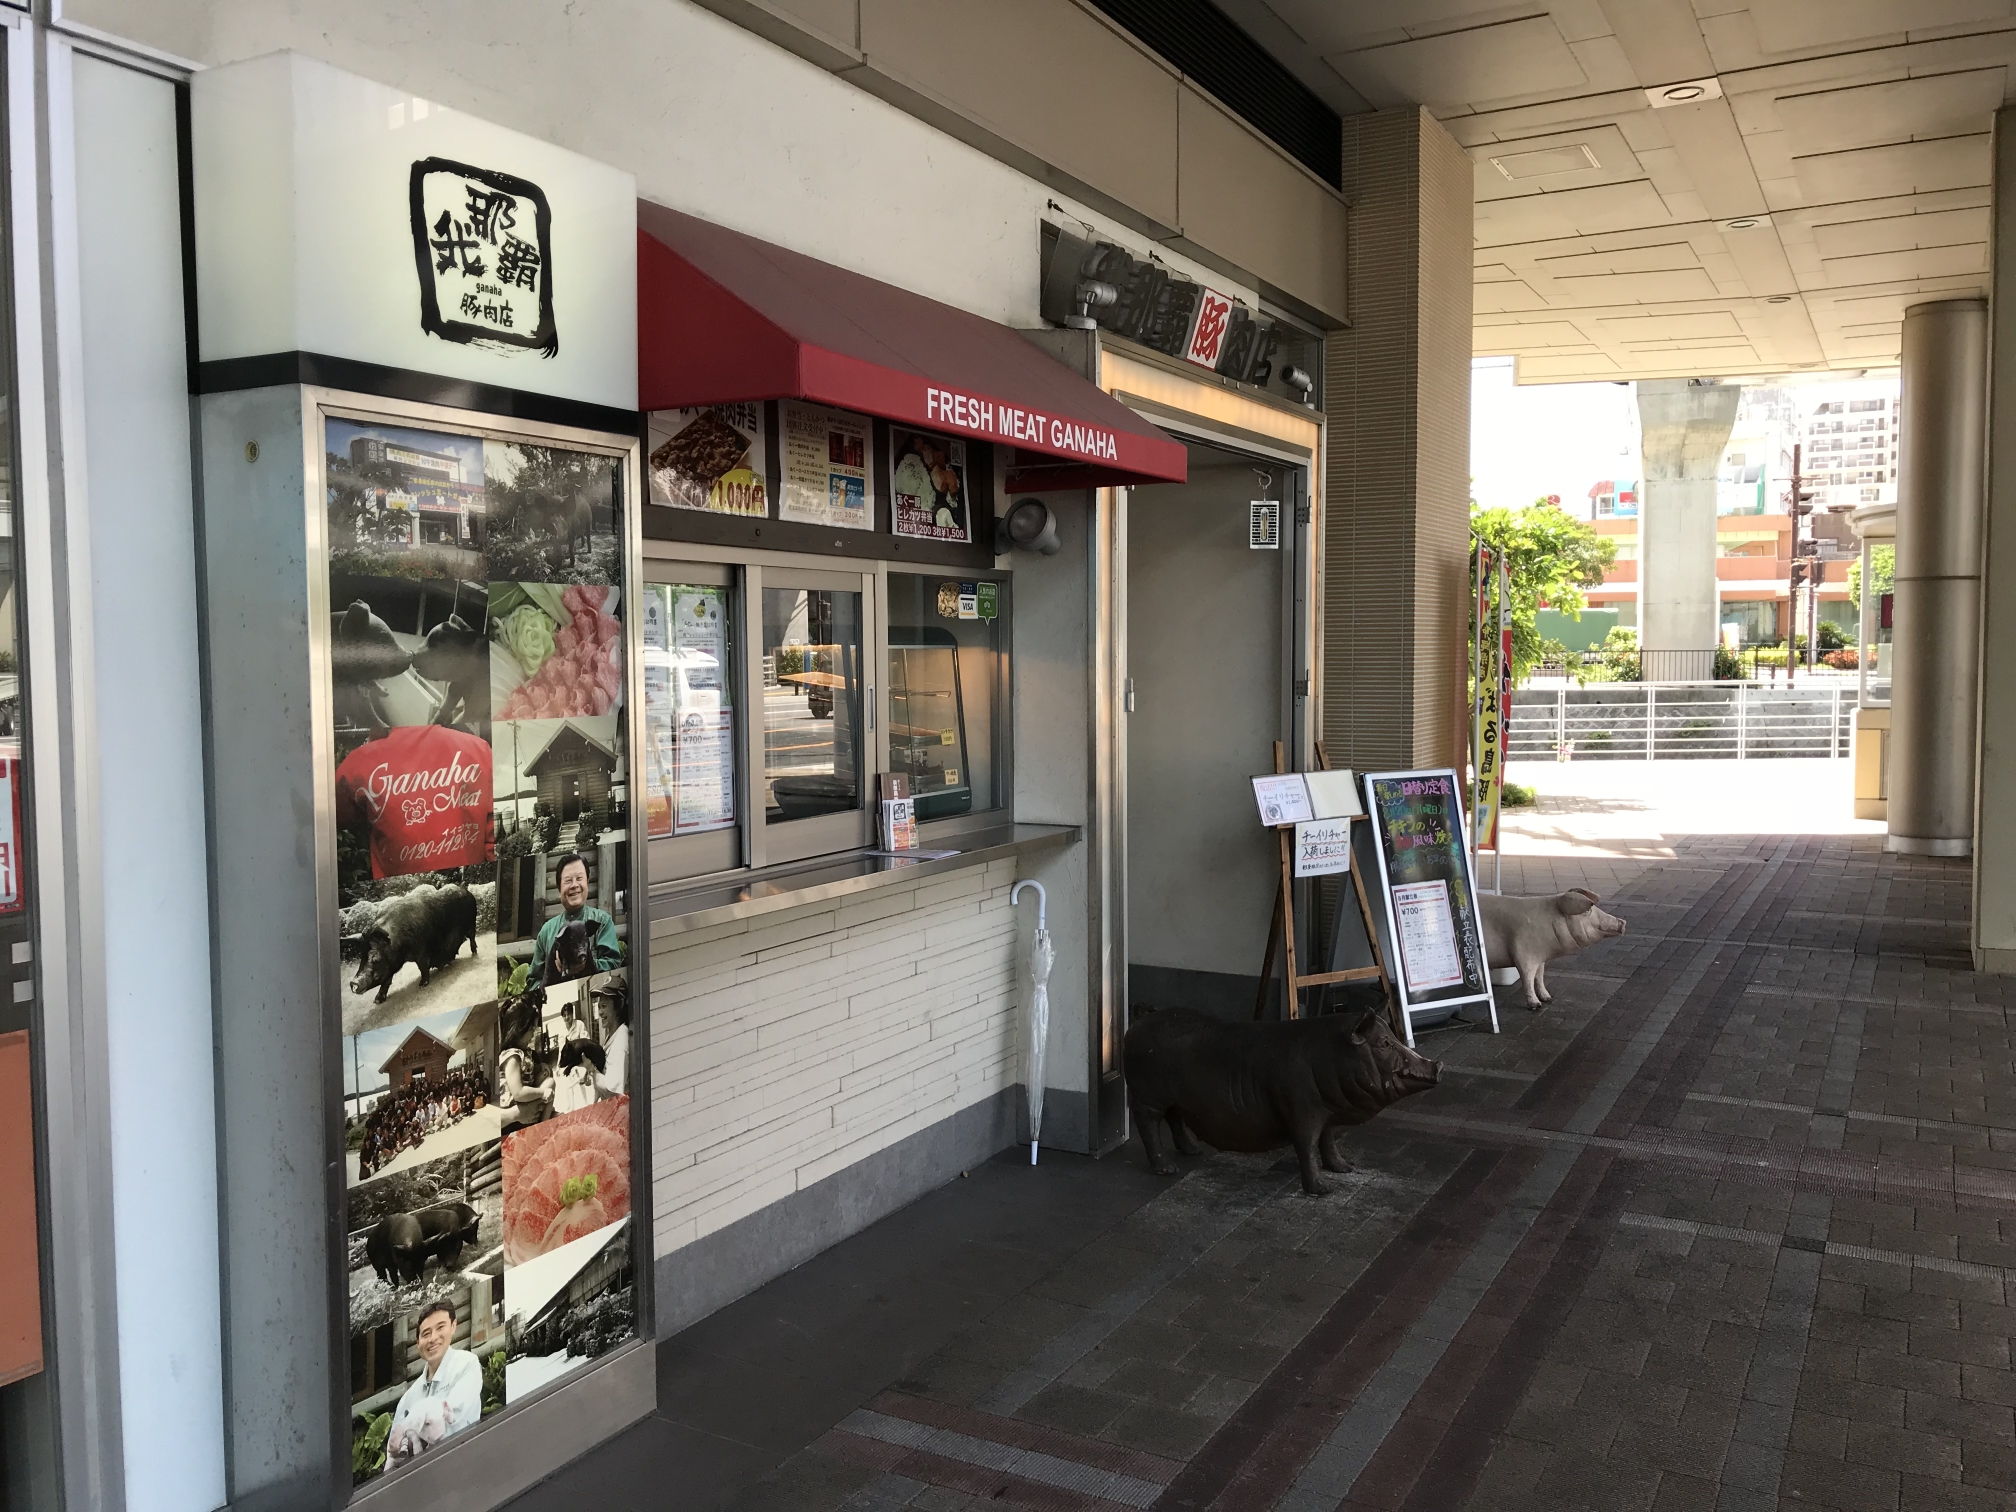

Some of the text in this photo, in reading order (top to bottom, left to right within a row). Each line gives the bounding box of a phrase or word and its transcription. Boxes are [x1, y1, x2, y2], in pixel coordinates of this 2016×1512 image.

[475, 282, 503, 296] ganaha
[460, 292, 514, 328] 豚肉店
[927, 387, 1118, 461] FRESH MEAT GANAHA
[897, 508, 933, 523] ヒレカツ弁当
[898, 522, 964, 539] 2枚¥1,200 3枚¥1,500
[962, 602, 974, 611] VISA
[682, 735, 703, 745] ¥700
[355, 751, 482, 823] Ganaha
[433, 785, 482, 812] Meat
[1388, 819, 1426, 834] チキンの
[1302, 828, 1347, 843] チーイリチャー
[1401, 907, 1419, 916] ¥700
